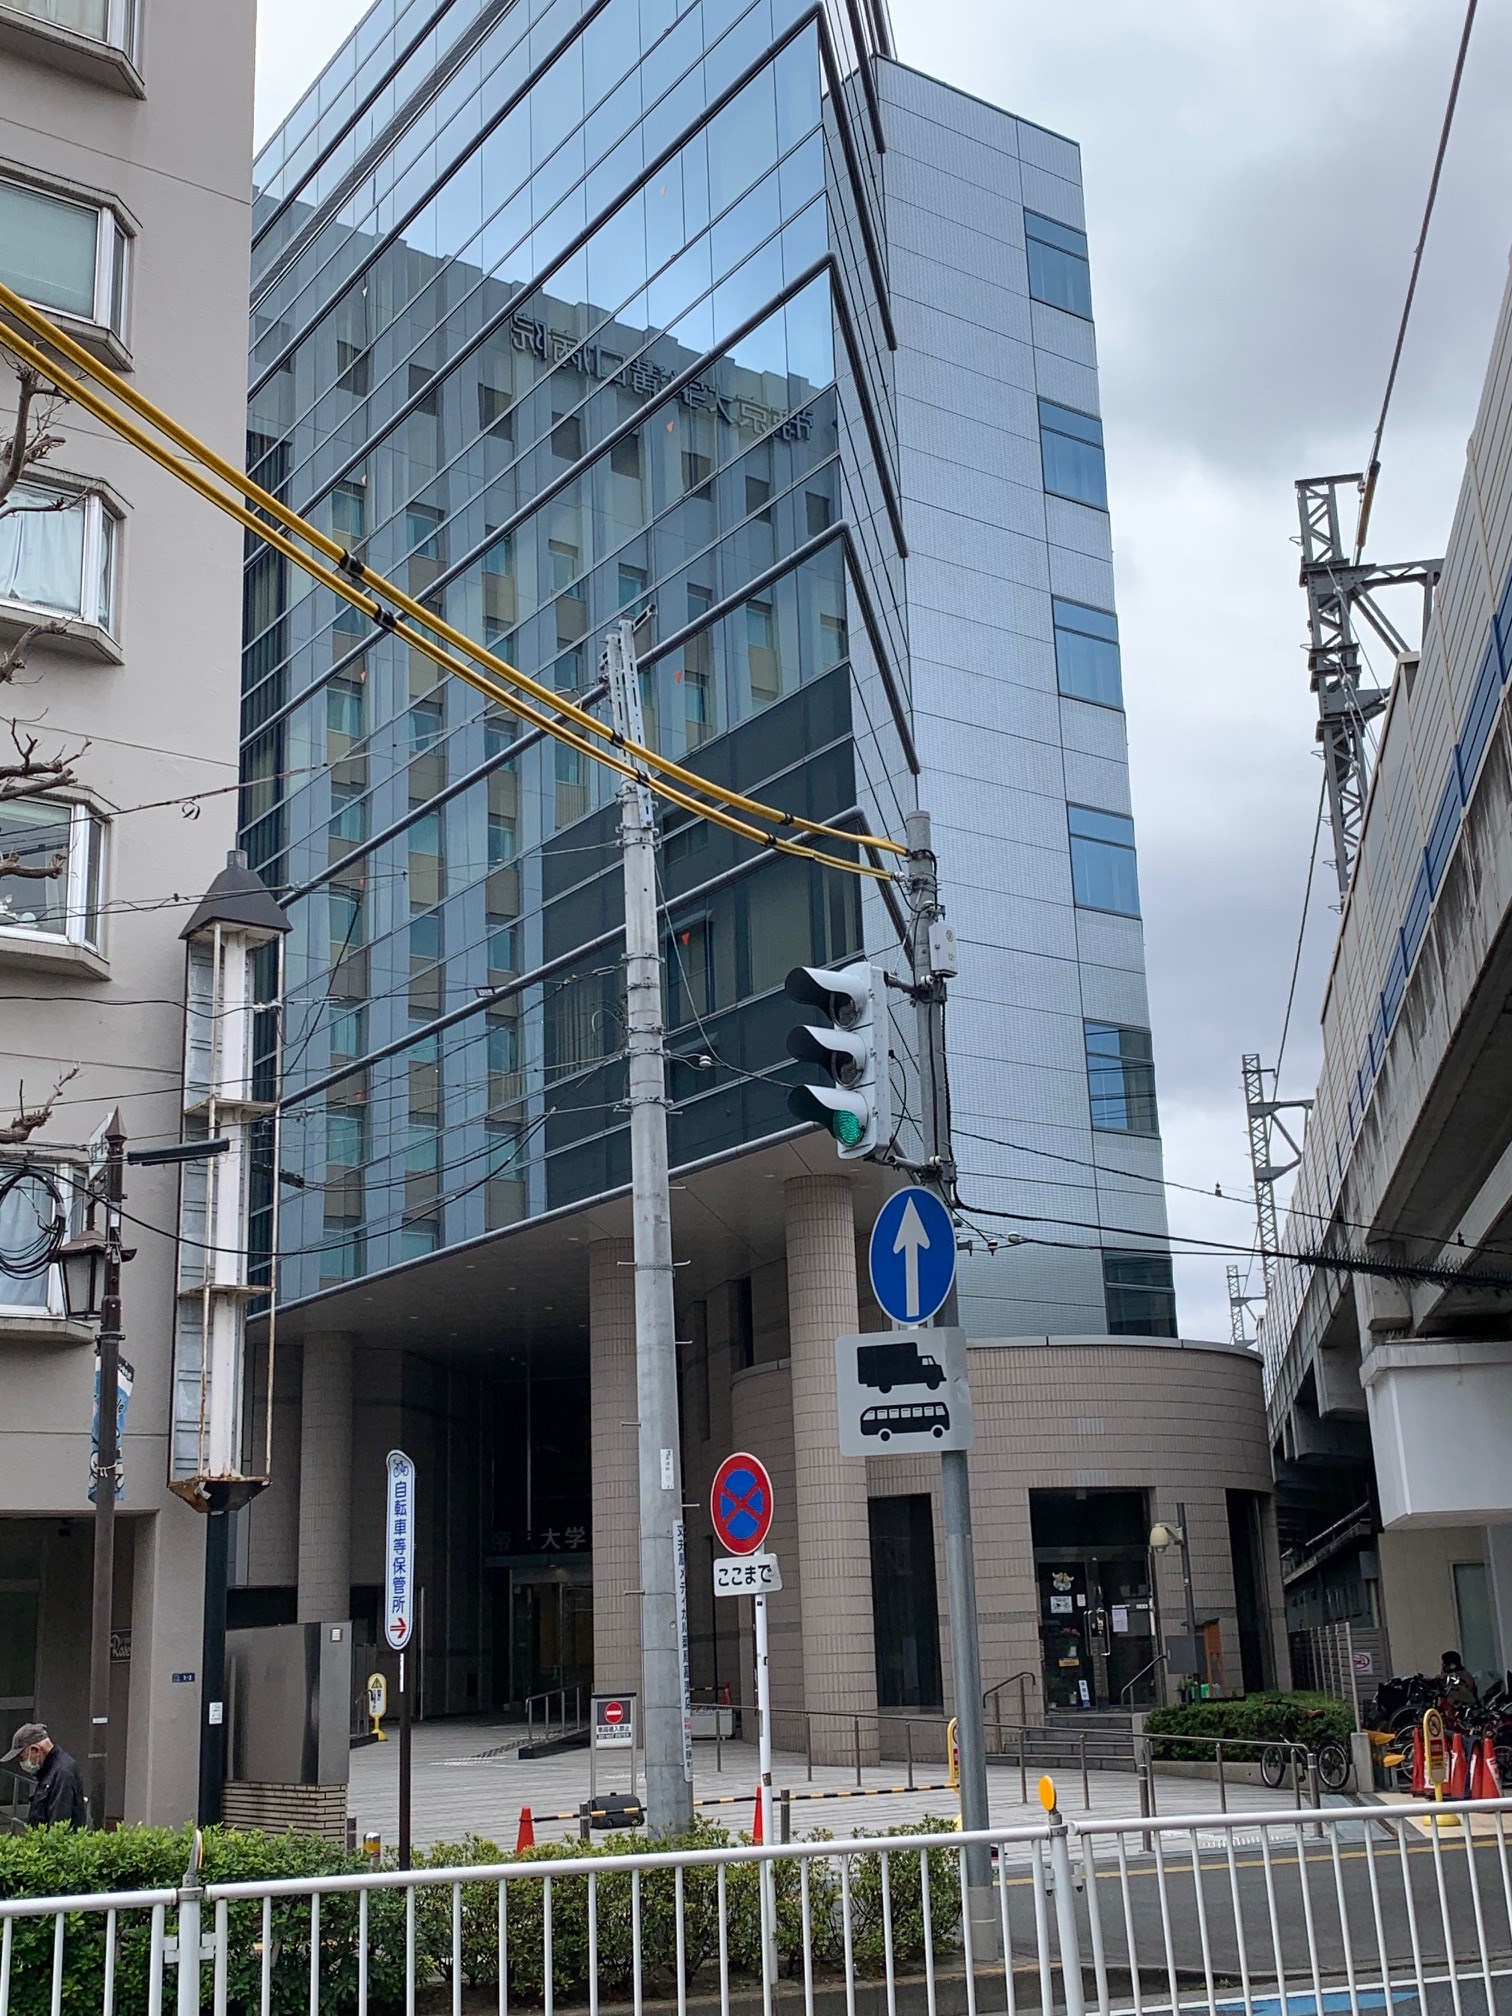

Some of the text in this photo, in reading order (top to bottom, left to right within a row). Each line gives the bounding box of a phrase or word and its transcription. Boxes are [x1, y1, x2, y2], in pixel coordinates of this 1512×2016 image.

[391, 1480, 408, 1614] 自転車等保管所
[718, 1565, 772, 1587] ここまで
